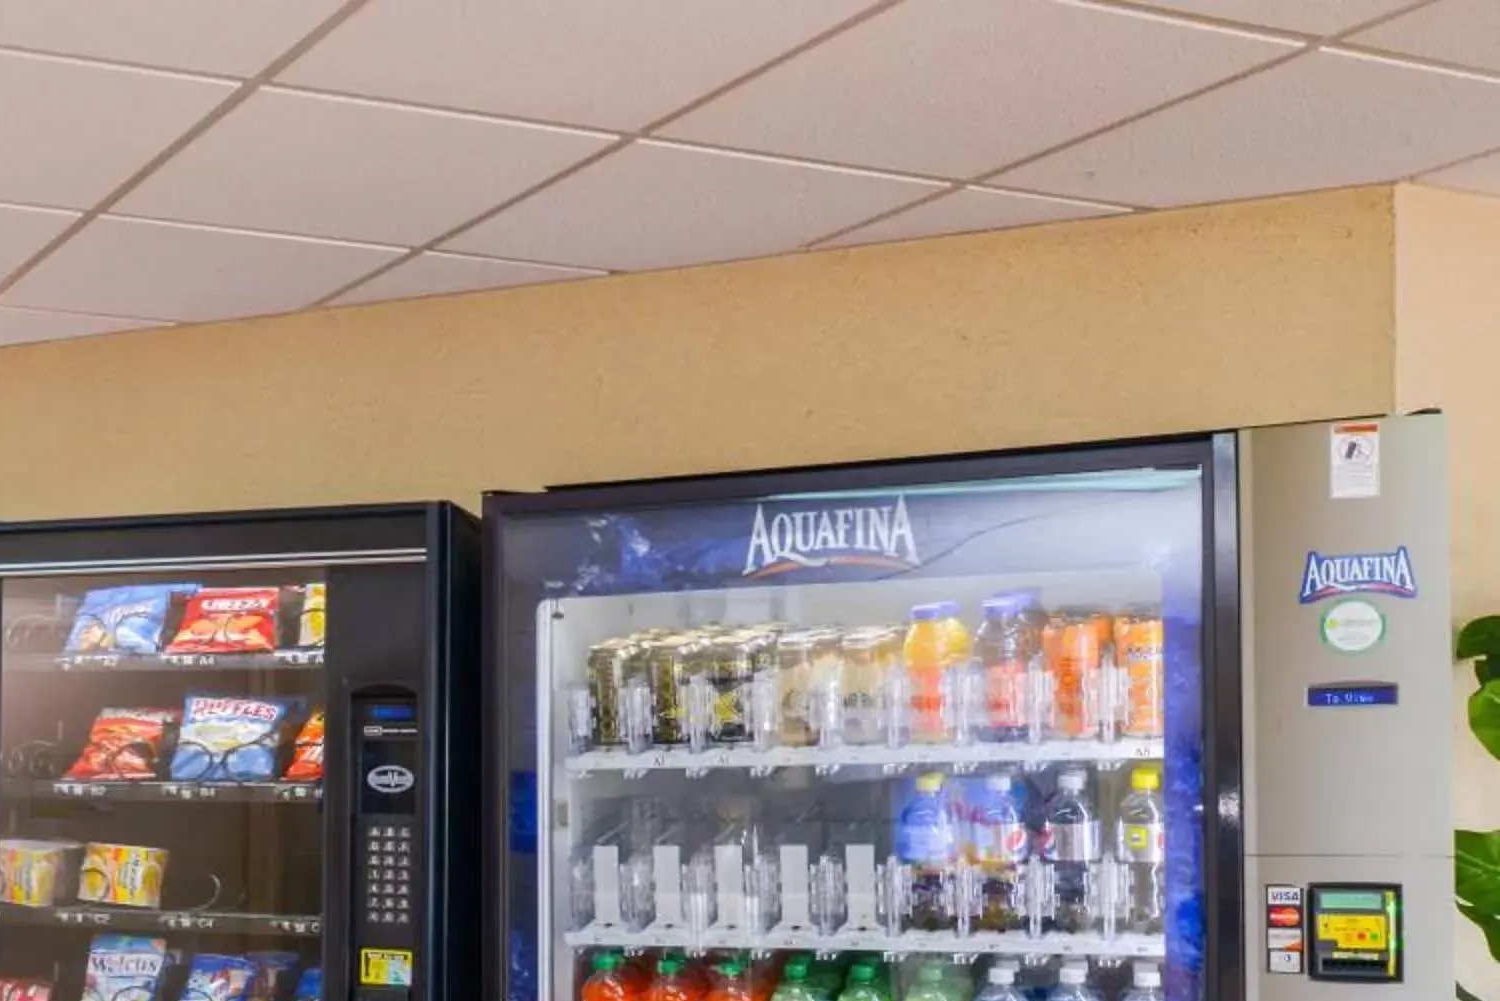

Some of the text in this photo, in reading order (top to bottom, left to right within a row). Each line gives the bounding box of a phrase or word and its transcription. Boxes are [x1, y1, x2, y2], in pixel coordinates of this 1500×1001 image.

[742, 493, 921, 577] AQUAFINA
[1302, 549, 1416, 597] AQUAFINA
[192, 699, 278, 720] RUFFLES
[1271, 891, 1300, 901] VISA
